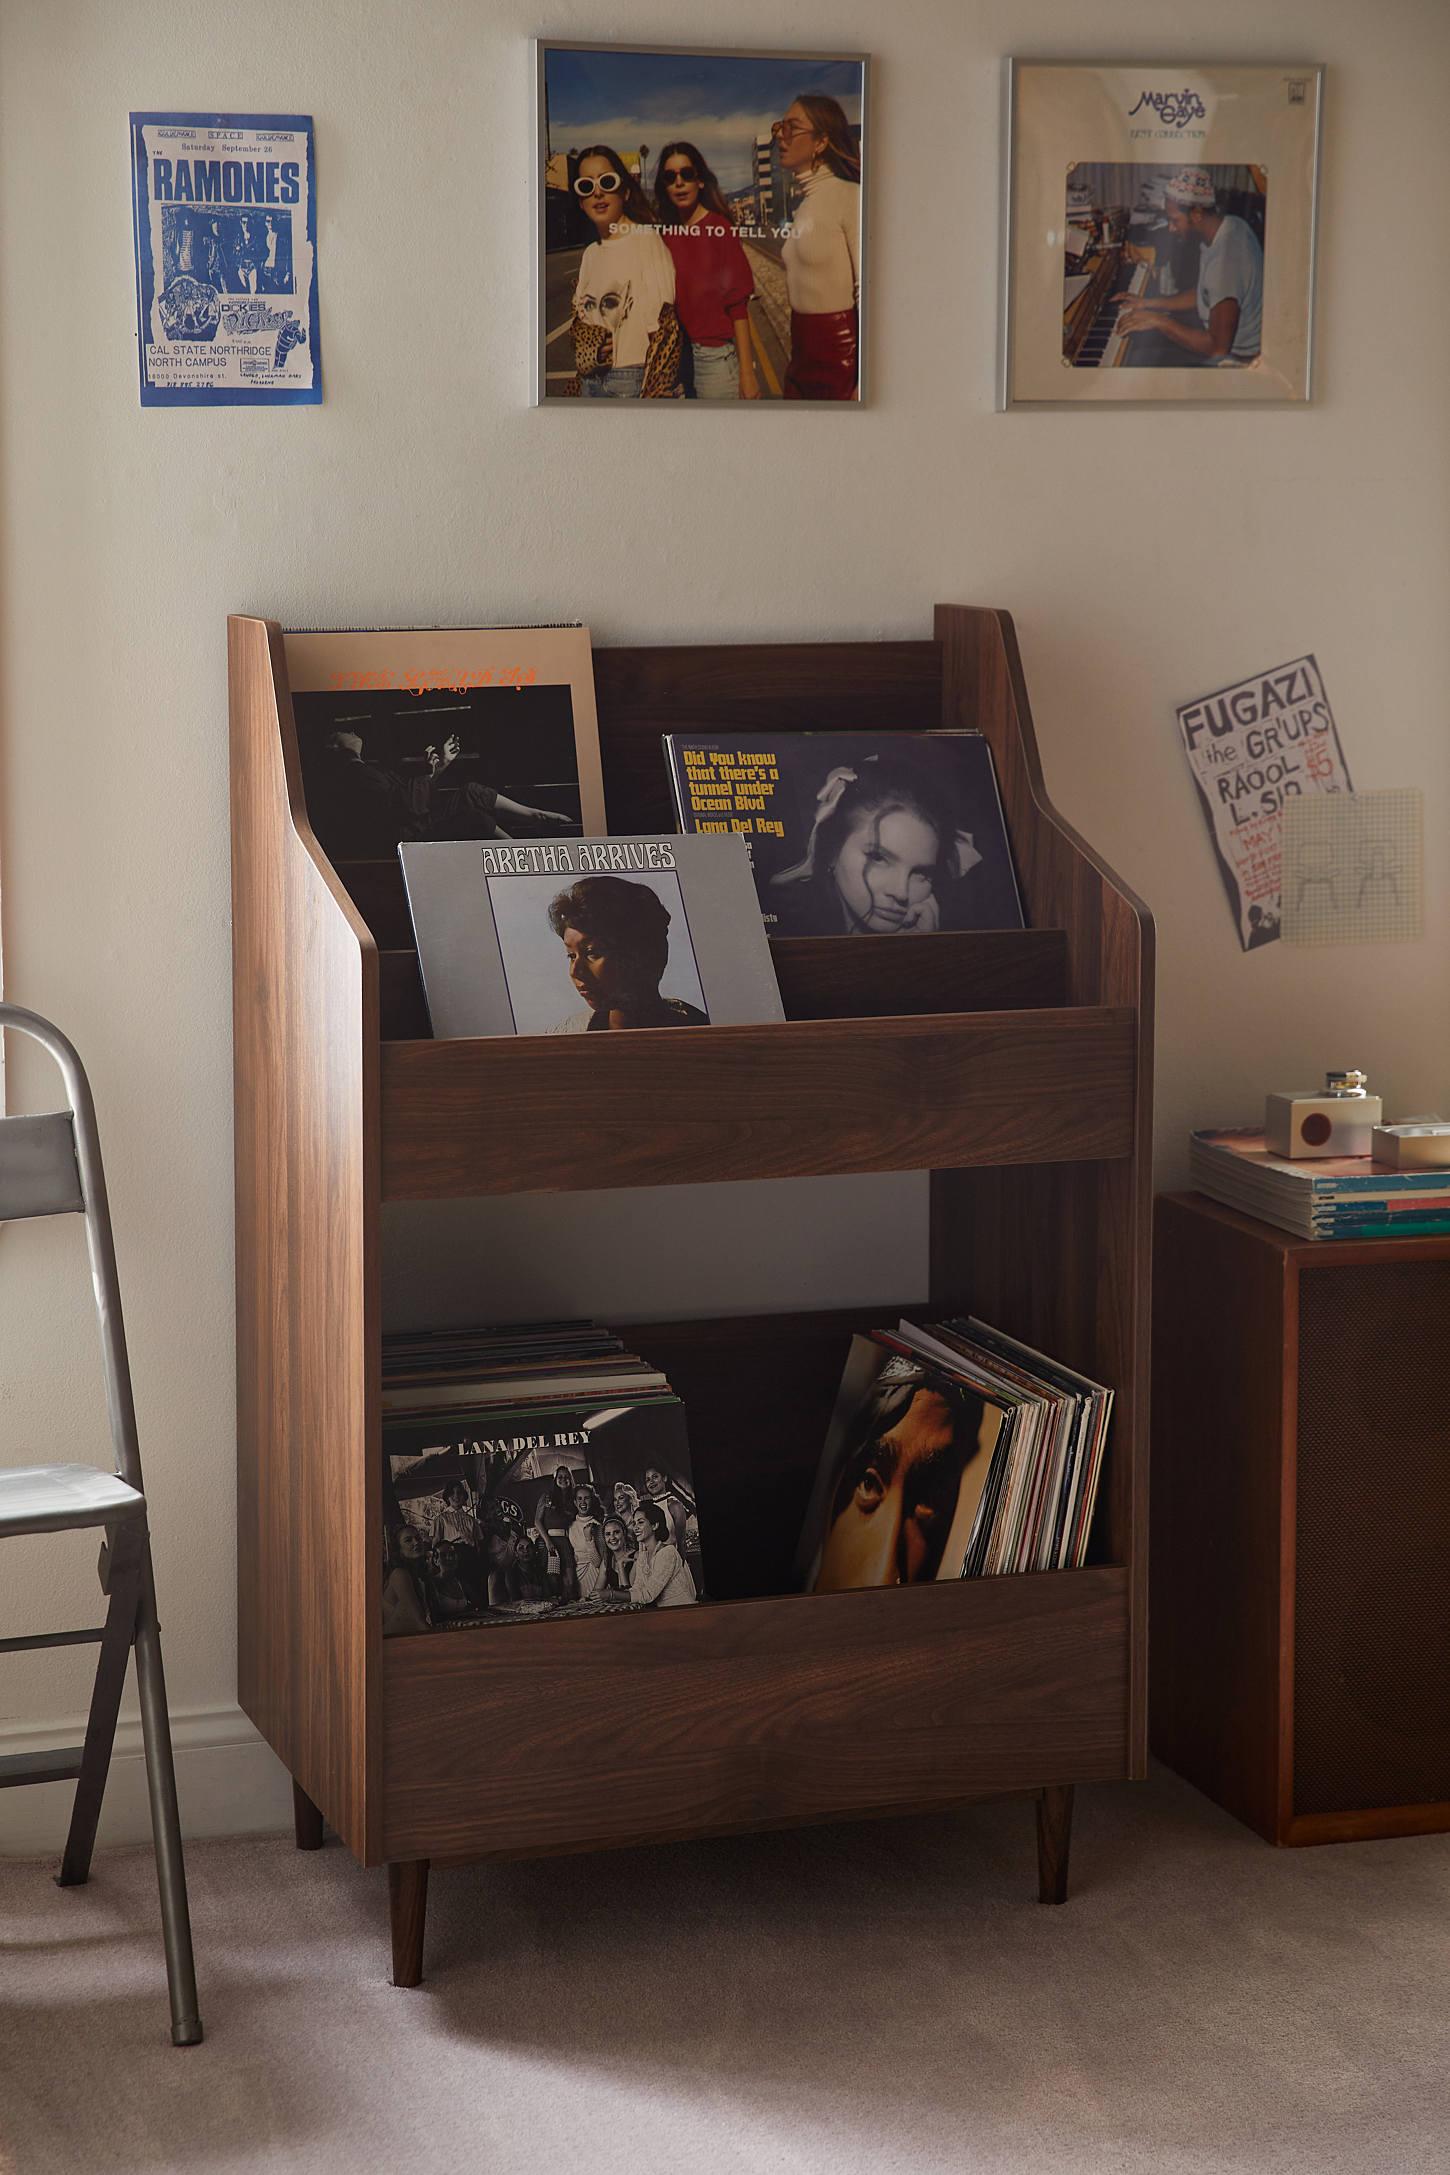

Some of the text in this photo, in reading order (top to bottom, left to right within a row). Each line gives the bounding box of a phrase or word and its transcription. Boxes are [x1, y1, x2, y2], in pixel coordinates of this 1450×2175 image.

[1128, 88, 1203, 116] Marvin
[1160, 105, 1206, 129] Gaye
[182, 143, 215, 152] Saturday
[222, 144, 261, 153] September
[153, 158, 300, 204] RAMONES
[608, 223, 801, 239] SOMETHING TO TELL YOU
[150, 345, 272, 356] CAL STATE NORTHRIDGE
[148, 357, 227, 367] NORTH CAMPUS
[1182, 667, 1314, 751] FUGAZI
[683, 751, 777, 765] Did You know
[1206, 743, 1238, 764] the
[686, 766, 779, 780] that there's a
[1217, 755, 1300, 804] RAOOL
[689, 781, 775, 795] tunnel under
[691, 796, 766, 811] Ocean Blvd
[695, 818, 785, 838] Lana Del Rey
[482, 843, 676, 874] ARETHA ARRIVES
[457, 1430, 592, 1456] LANA DEL REY
